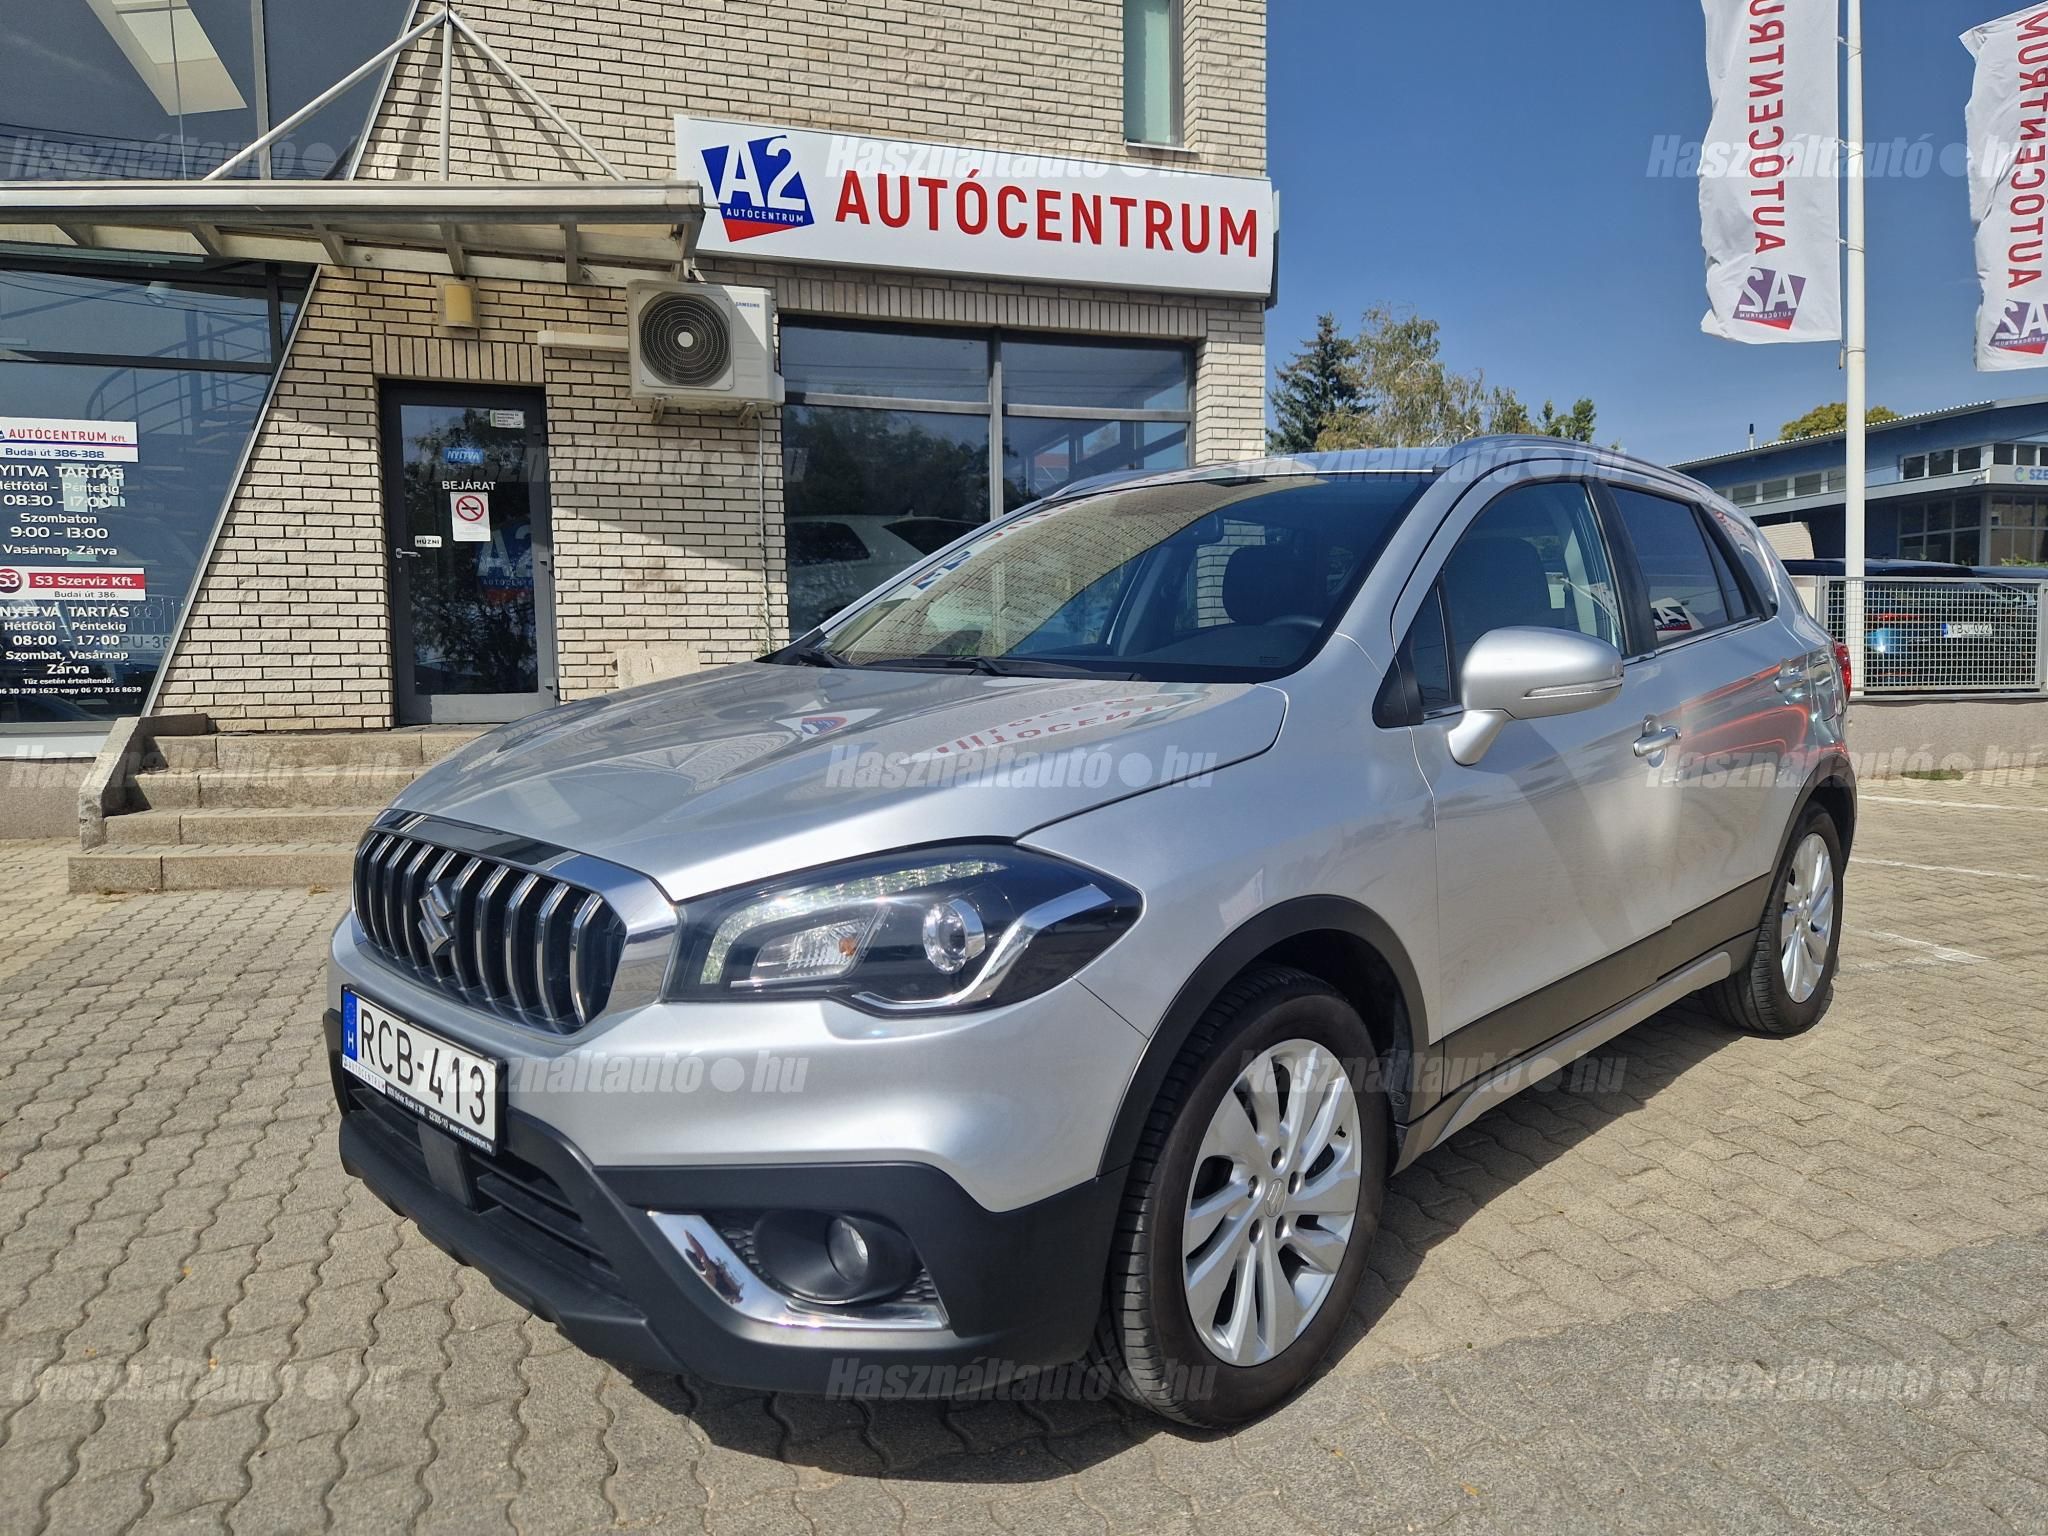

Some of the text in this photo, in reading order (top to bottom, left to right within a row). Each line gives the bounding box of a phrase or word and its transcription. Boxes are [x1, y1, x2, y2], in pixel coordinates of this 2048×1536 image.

[718, 137, 806, 212] A2
[726, 206, 804, 224] AUTÓCENTRUM
[835, 168, 1257, 258] AUTÓCENTRUM
[9, 427, 108, 442] AUTÓCENTRUM
[5, 447, 105, 459] Budai út 386-388
[55, 463, 125, 480] TARTÁS
[63, 482, 120, 496] Péntekig
[442, 479, 496, 491] BEJÁRAT
[3, 494, 53, 506] 08:30
[69, 496, 112, 508] 17:00
[20, 512, 98, 524] Szombaton
[10, 526, 50, 538] 9:00
[66, 527, 109, 539] 13:00
[2, 543, 118, 557] Vasárnap: Zárva
[35, 575, 137, 587] S3 Szerviz Kft.
[54, 590, 82, 599] Budai
[85, 590, 95, 599] út
[0, 603, 130, 618] NYITVA TARTÁS
[4, 621, 56, 632] Hétfőtől
[72, 621, 127, 633] Péntekig
[12, 635, 57, 646] 08:00
[77, 635, 120, 646] 17:00
[5, 650, 129, 662] Szombat, Vasárnap
[46, 662, 90, 675] Zárva
[9, 687, 20, 695] 30
[361, 1008, 486, 1125] RCB-413
